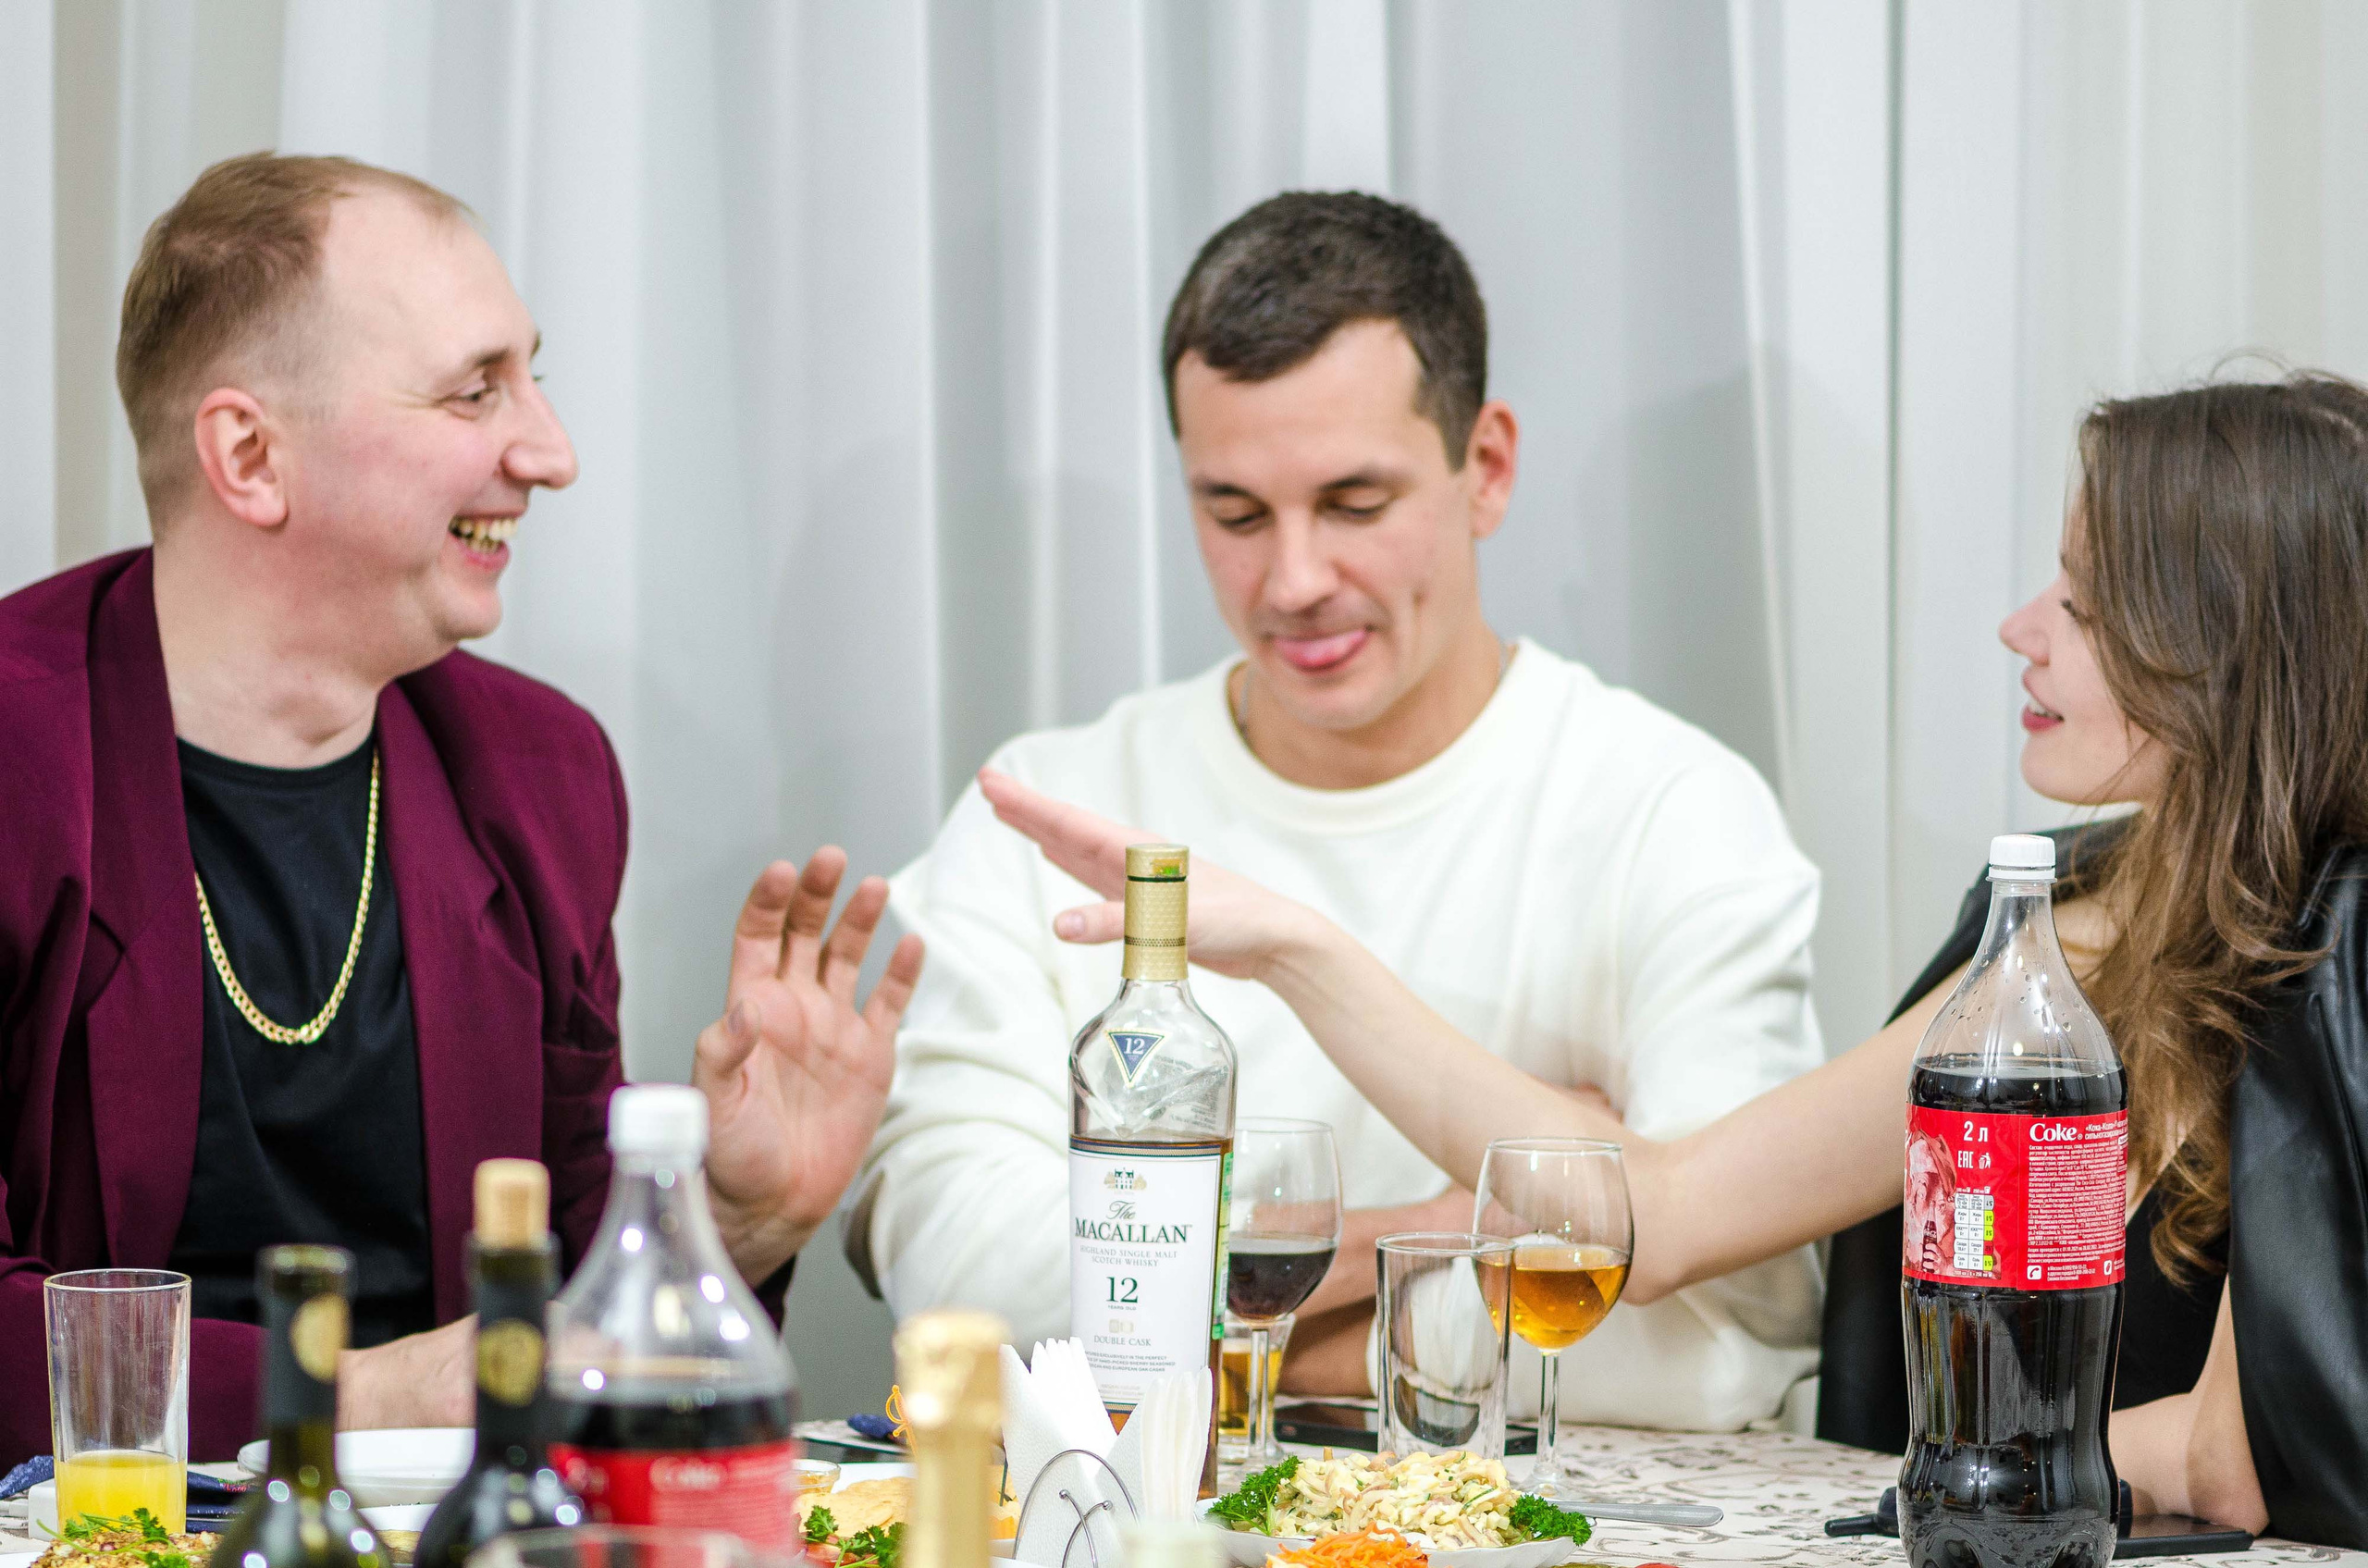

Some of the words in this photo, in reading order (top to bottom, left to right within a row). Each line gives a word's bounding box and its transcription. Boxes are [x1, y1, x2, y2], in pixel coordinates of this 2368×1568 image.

[1123, 1037, 1146, 1055] 12
[1963, 1120, 1974, 1142] 2
[1978, 1127, 1988, 1142] л
[2029, 1122, 2078, 1142] Coke
[1105, 1200, 1136, 1220] The
[1075, 1216, 1189, 1244] MACALLAN
[1079, 1244, 1116, 1256] HIGHLAND
[1119, 1248, 1151, 1258] SINGLE
[1154, 1250, 1178, 1259] MALT
[1092, 1255, 1122, 1266] SCOTCH
[1125, 1258, 1159, 1267] WHISKY
[1105, 1277, 1139, 1303] 12
[1093, 1335, 1126, 1346] DOUBLE
[1128, 1338, 1152, 1347] CASK
